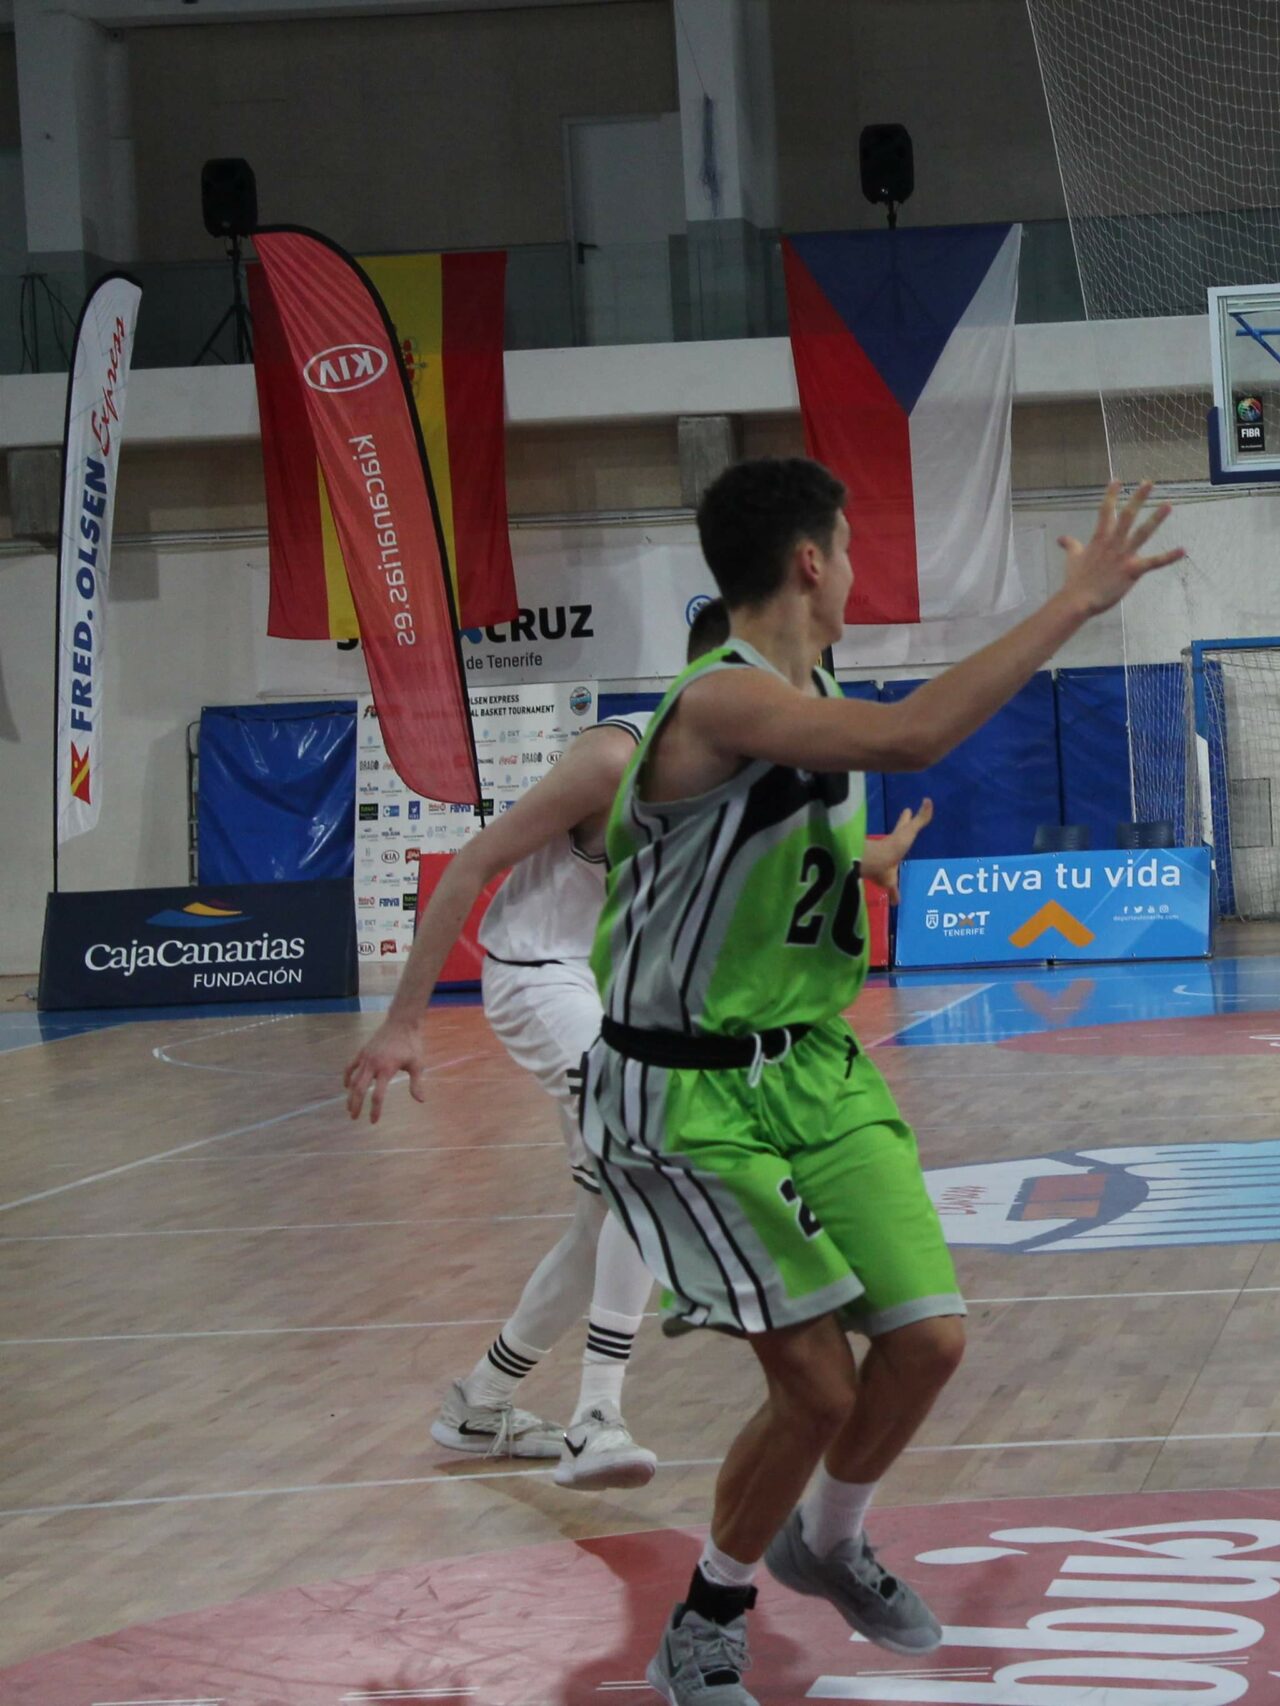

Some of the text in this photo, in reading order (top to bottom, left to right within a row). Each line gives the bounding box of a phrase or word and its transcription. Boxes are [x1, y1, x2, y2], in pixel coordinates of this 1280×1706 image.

[90, 314, 127, 457] Express
[1241, 427, 1261, 438] FIBA
[75, 456, 107, 600] OLSEN
[466, 652, 543, 670] de Tenerife
[470, 694, 520, 705] LSEN EXPRESS
[481, 707, 507, 717] BASKET
[508, 704, 555, 716] TOURNAMENT
[927, 859, 1181, 896] Activa tu vida
[943, 910, 991, 929] DXT
[943, 928, 985, 937] TENERIFE
[84, 932, 306, 977] CajaCanarias
[193, 966, 303, 989] FUNDACIÓN
